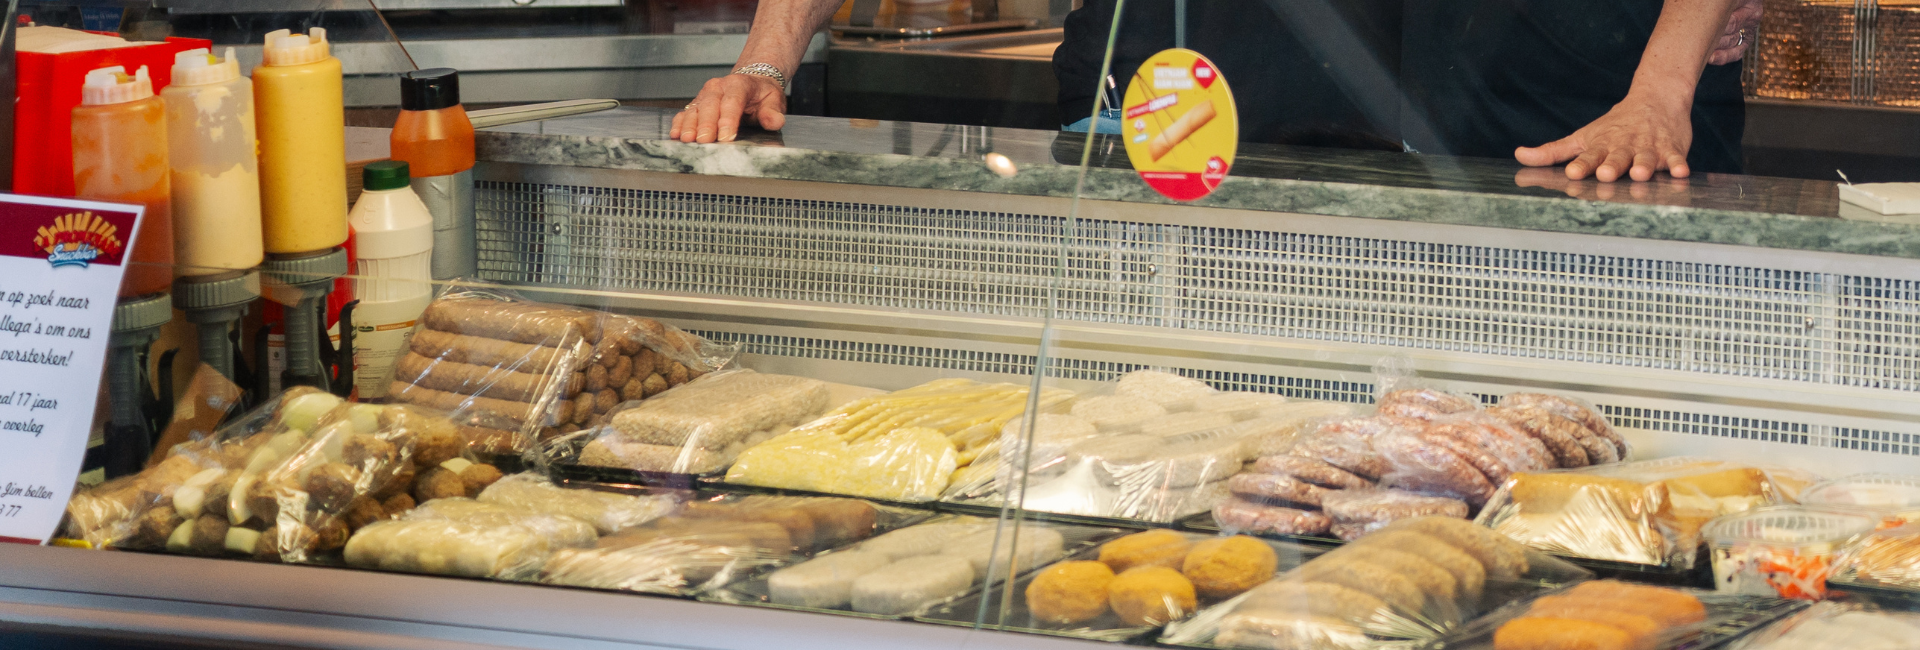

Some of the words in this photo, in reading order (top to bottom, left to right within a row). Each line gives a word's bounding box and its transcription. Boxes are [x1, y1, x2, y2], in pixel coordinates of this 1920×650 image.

[47, 242, 97, 262] Snackbar
[7, 291, 24, 307] op
[24, 289, 55, 309] zoek
[55, 296, 90, 309] naar
[0, 315, 42, 337] llega's
[45, 325, 65, 337] om
[67, 327, 91, 339] ons
[0, 348, 74, 366] versterken!
[19, 392, 32, 406] 17
[31, 393, 58, 411] jaar
[3, 418, 44, 437] overleg
[23, 485, 54, 500] bellen
[5, 505, 22, 517] 77
